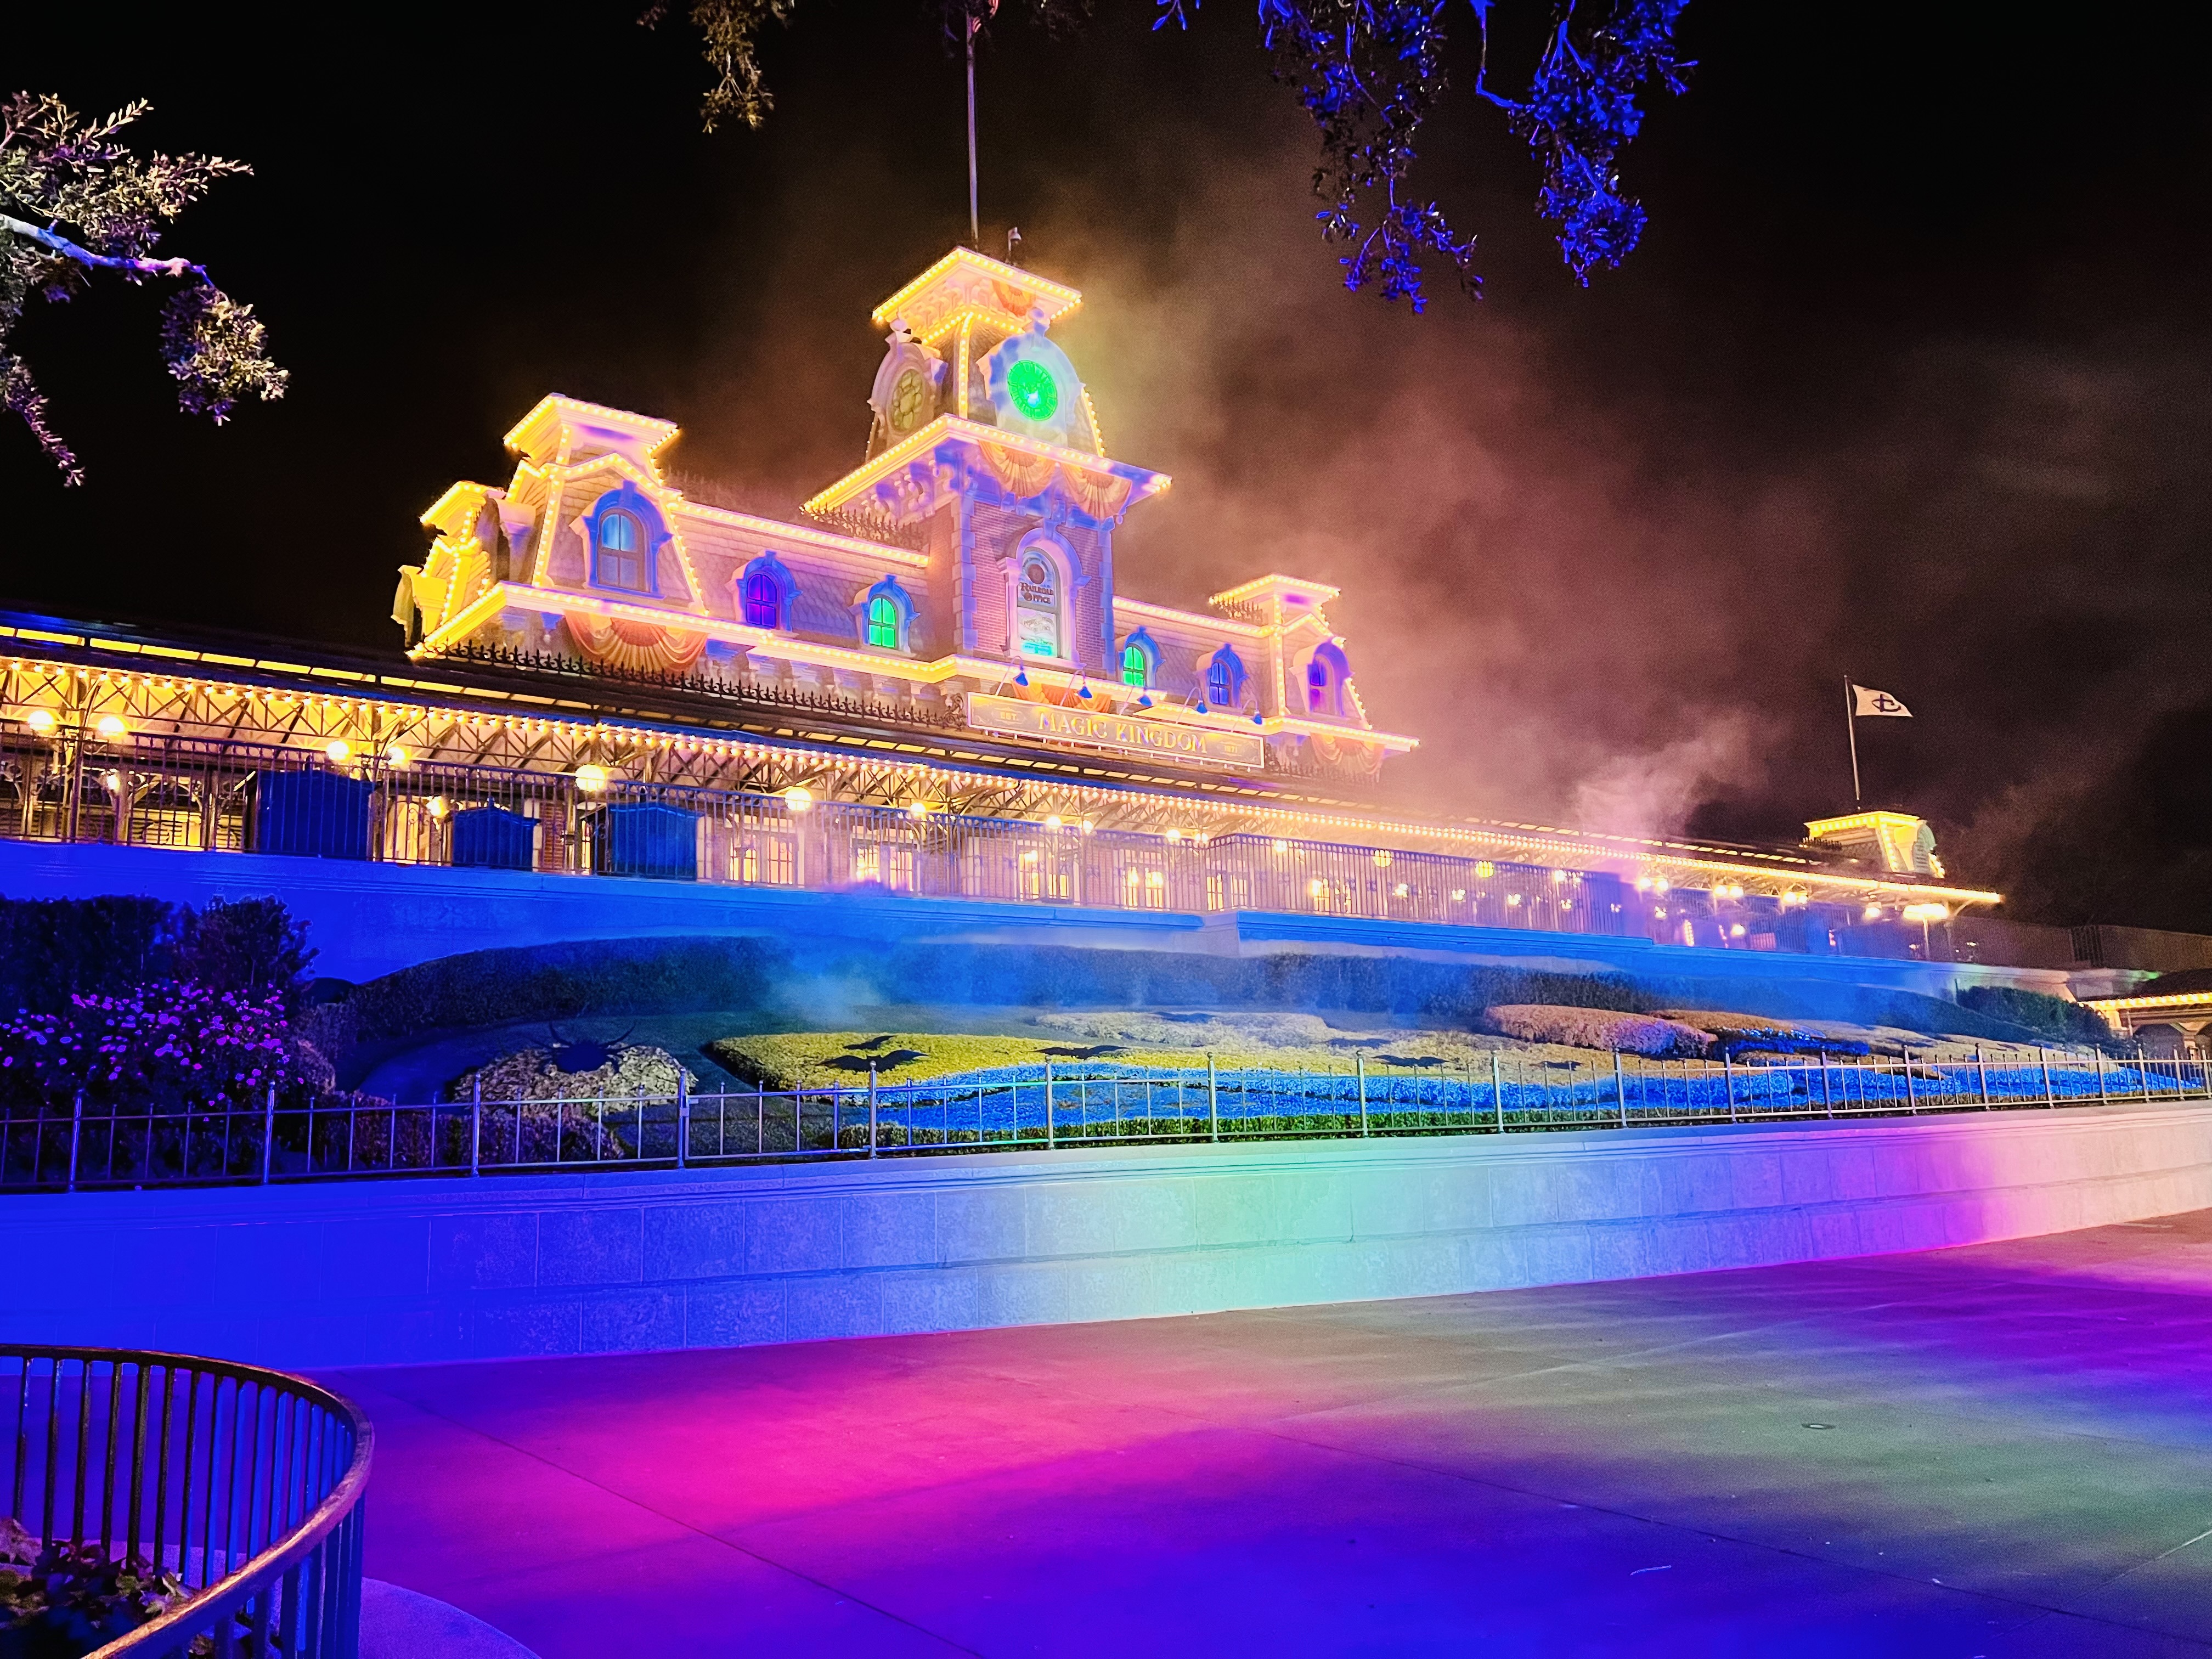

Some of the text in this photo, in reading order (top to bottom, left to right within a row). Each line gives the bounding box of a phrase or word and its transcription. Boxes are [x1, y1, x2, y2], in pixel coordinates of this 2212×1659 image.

[1020, 582, 1054, 595] RAILROAD
[1039, 712, 1108, 738] MAGIC
[1115, 722, 1207, 754] KINGDOM
